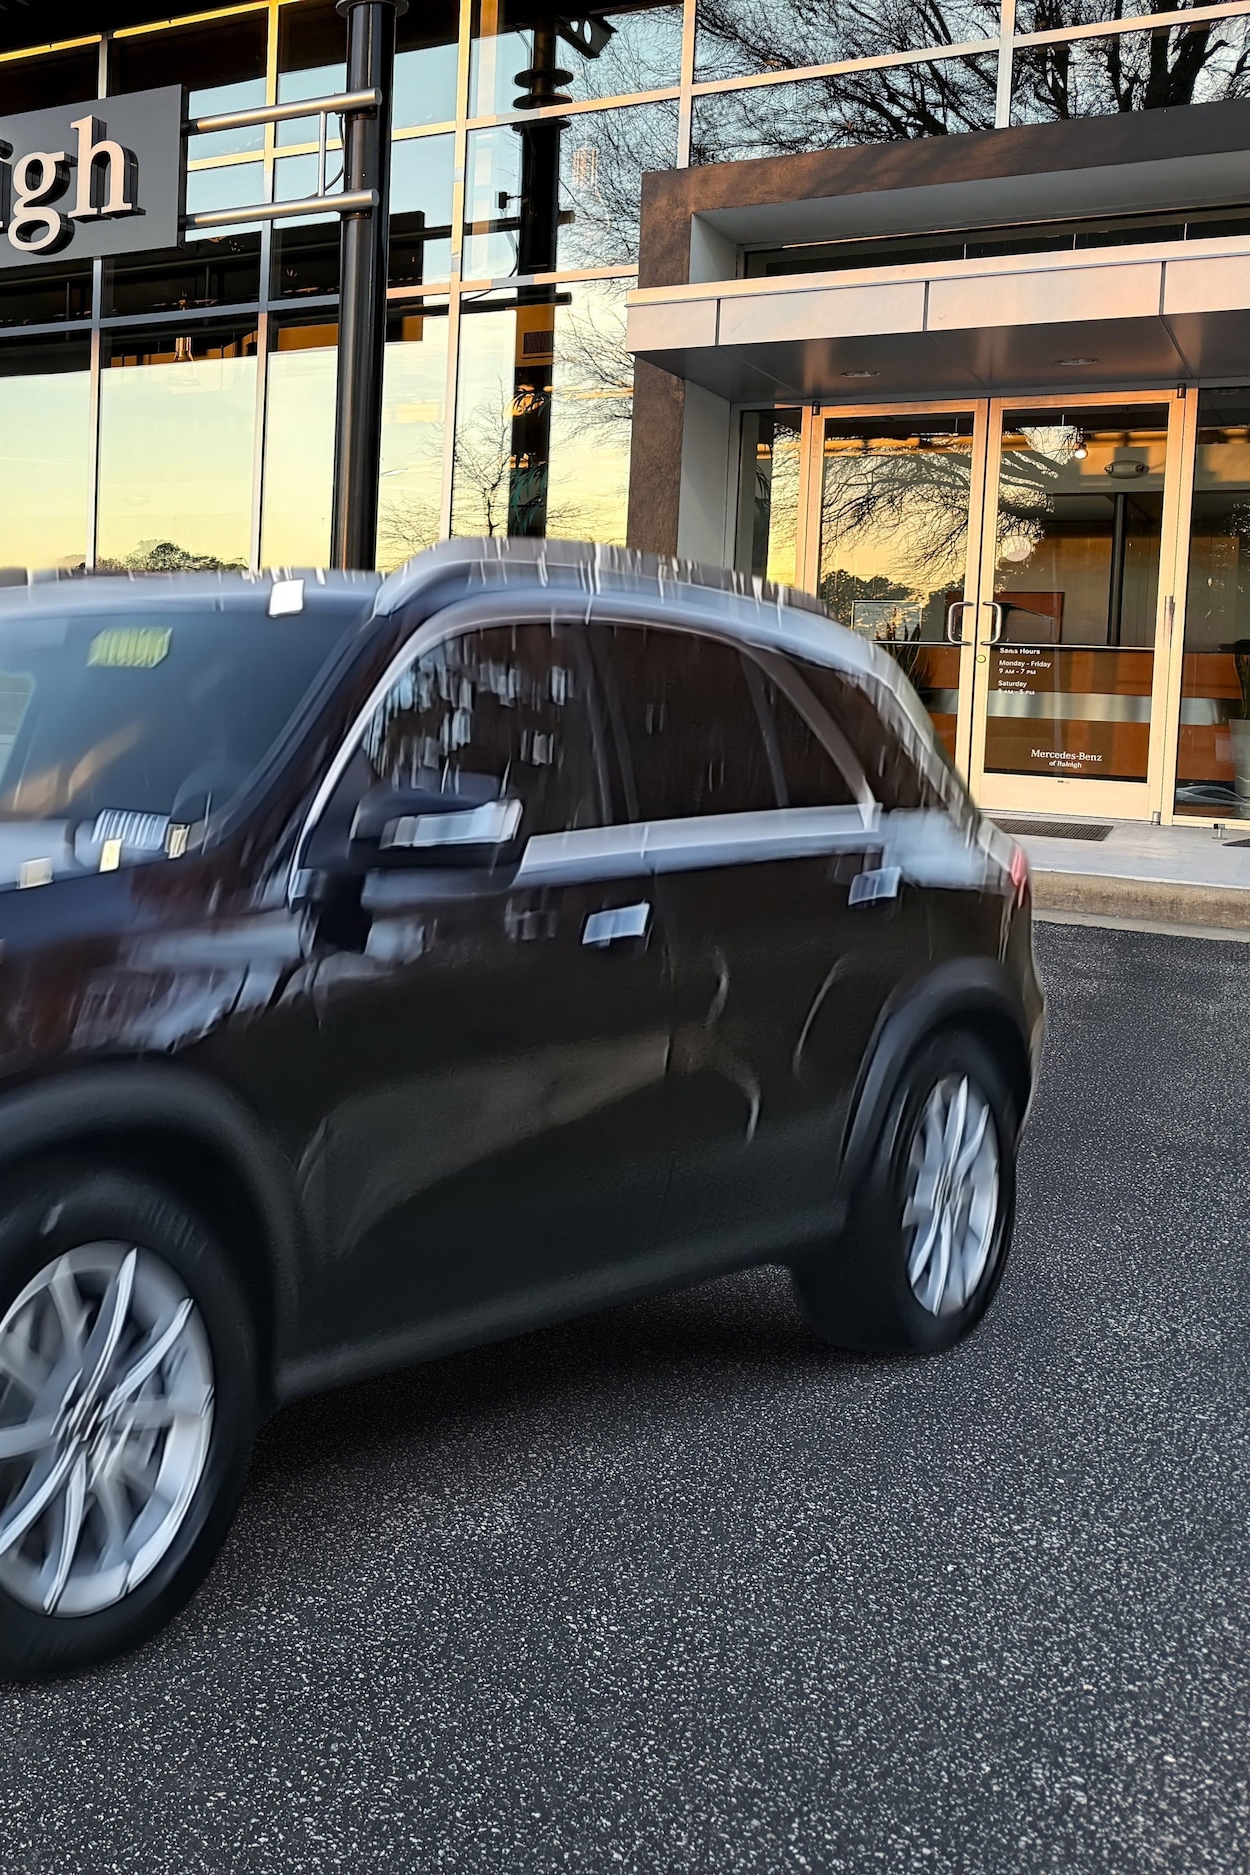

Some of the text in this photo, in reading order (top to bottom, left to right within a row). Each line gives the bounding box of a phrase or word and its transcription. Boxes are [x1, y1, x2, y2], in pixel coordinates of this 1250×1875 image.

[1019, 647, 1041, 655] Hours
[998, 660, 1026, 668] Monday
[1030, 660, 1052, 669] Friday
[997, 680, 1028, 689] Saturday
[1030, 748, 1103, 762] Mercedes-Benz
[1056, 760, 1083, 769] Raleigh
